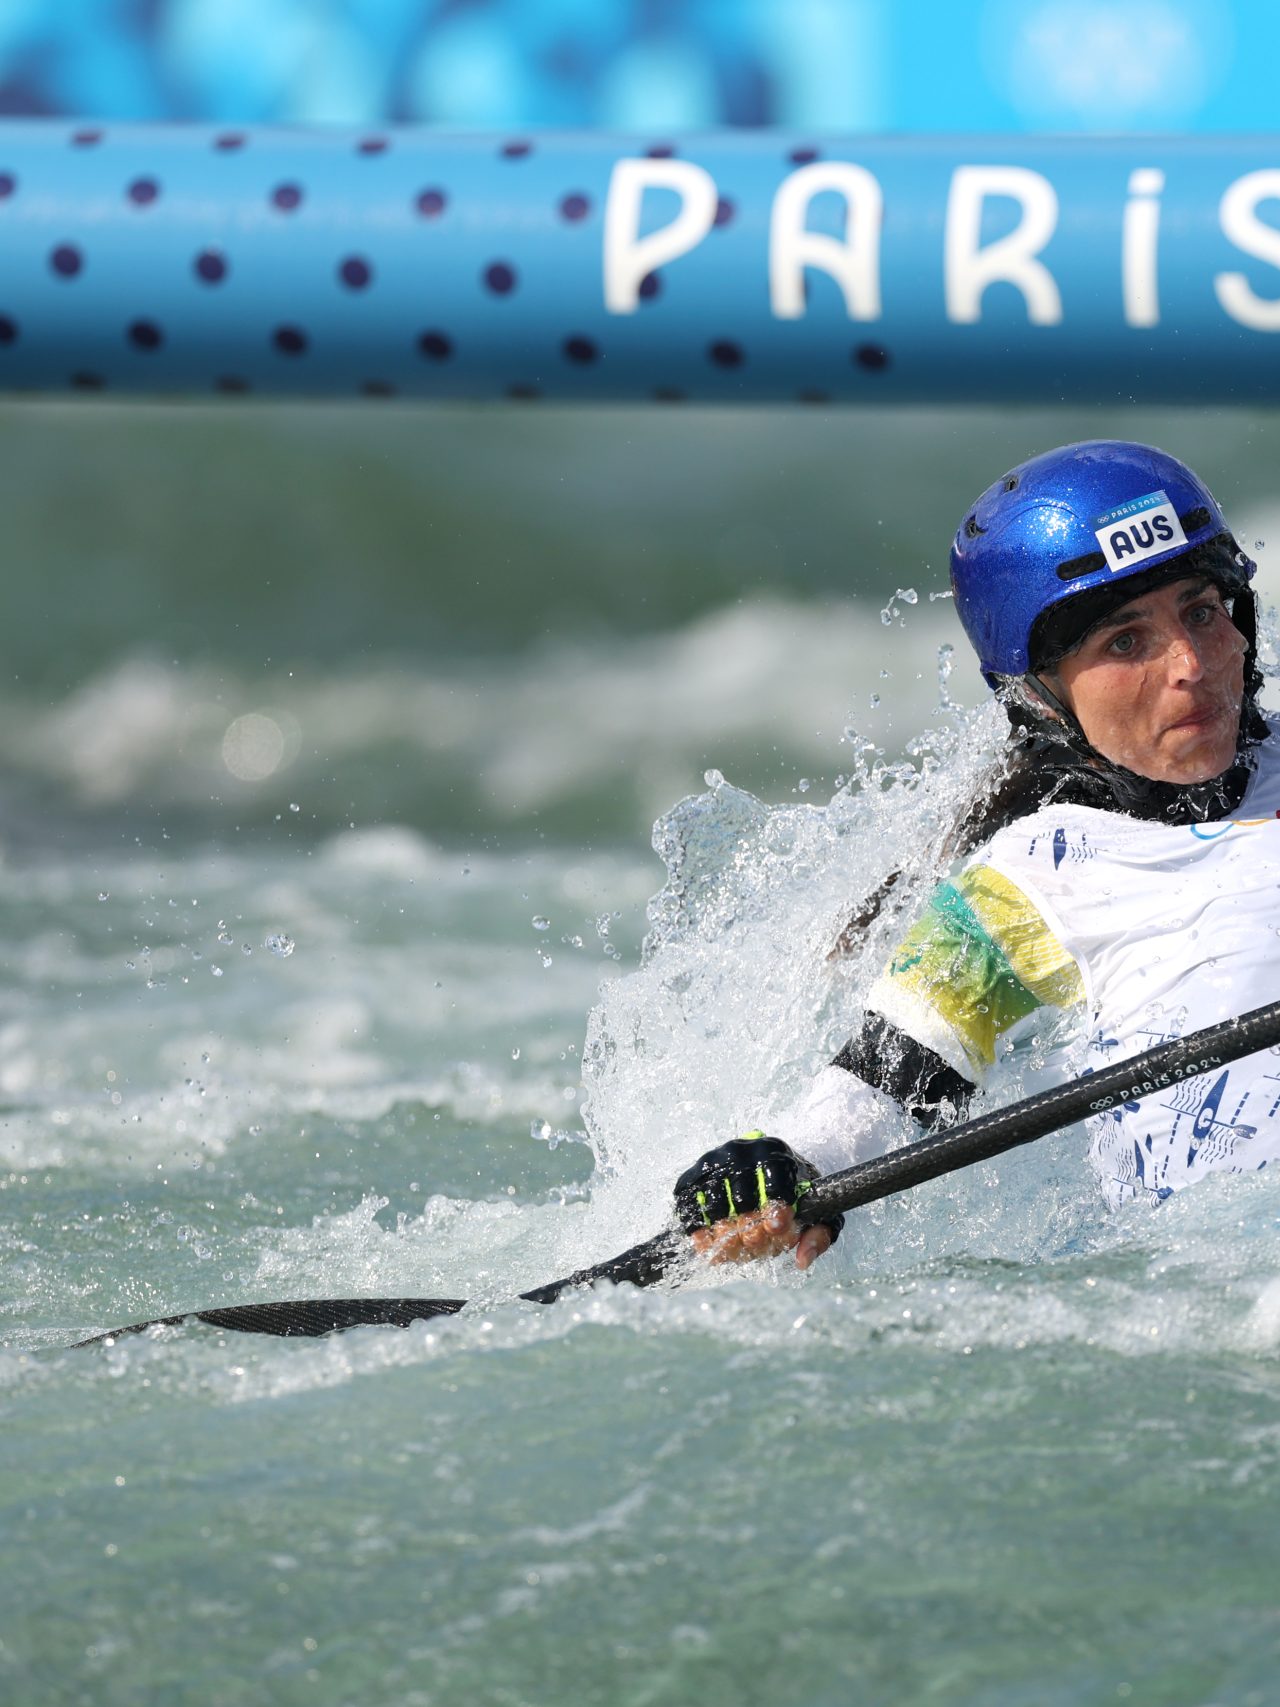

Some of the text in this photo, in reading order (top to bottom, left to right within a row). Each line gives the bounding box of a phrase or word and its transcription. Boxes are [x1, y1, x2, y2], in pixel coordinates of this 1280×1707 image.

[1111, 504, 1137, 519] PARIS
[1109, 515, 1174, 560] AUS
[1119, 1056, 1222, 1100] PARIS 2024
